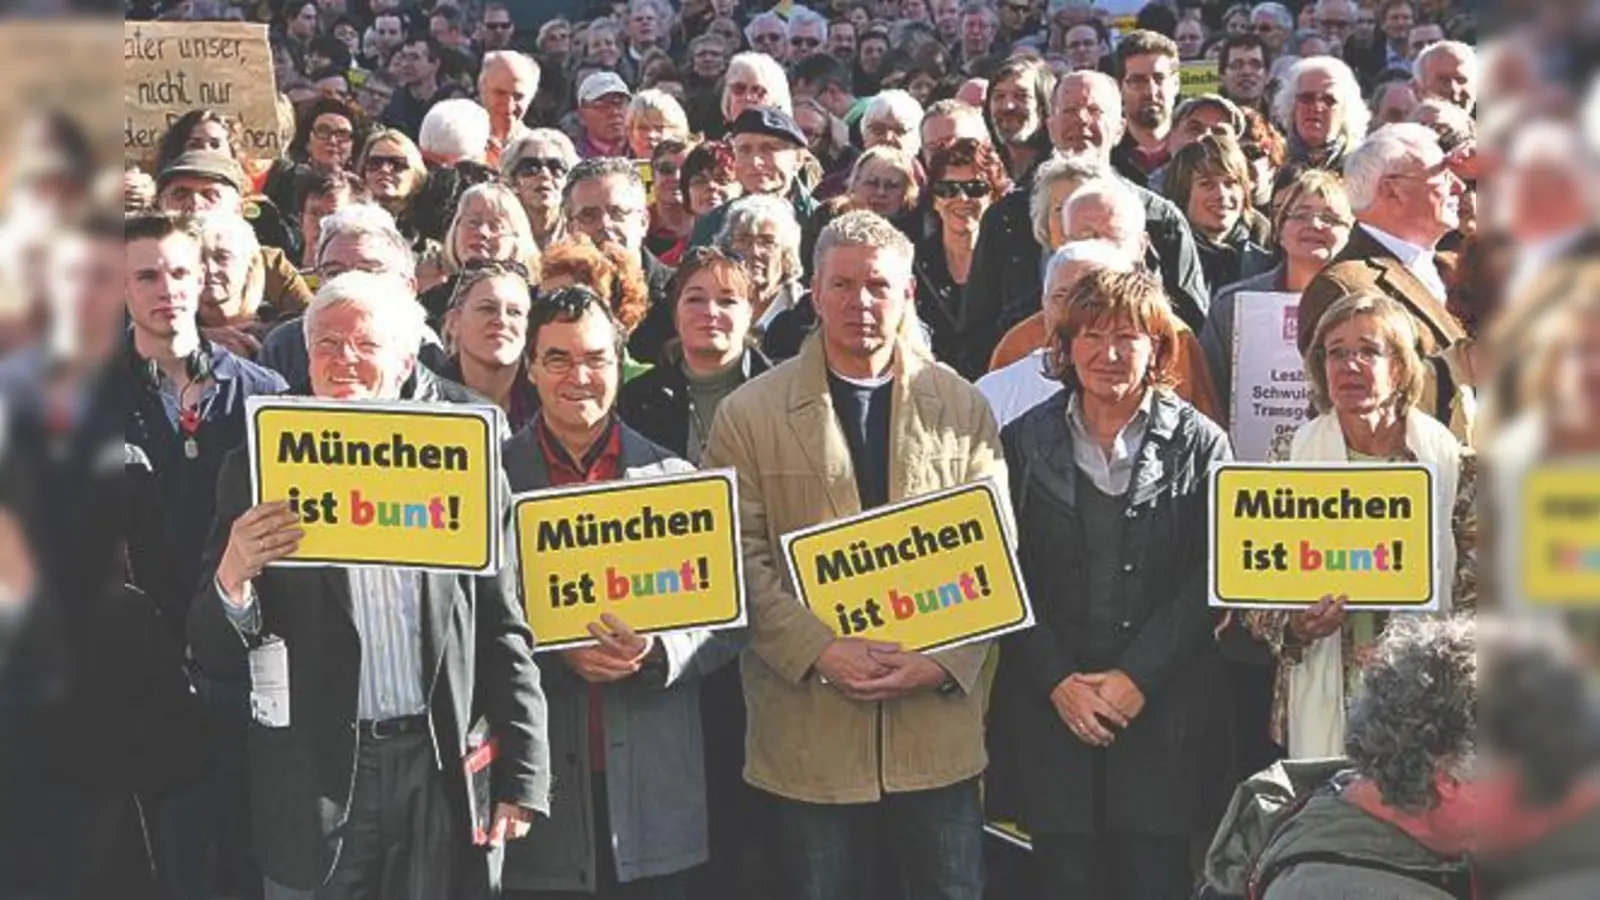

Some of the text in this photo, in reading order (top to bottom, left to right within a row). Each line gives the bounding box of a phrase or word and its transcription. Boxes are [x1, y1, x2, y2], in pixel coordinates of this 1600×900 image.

[178, 37, 246, 65] unser,
[138, 69, 232, 105] nicht nur
[1252, 385, 1309, 400] Schwul
[1270, 368, 1304, 383] Lesb
[1253, 402, 1304, 421] Transg
[277, 429, 469, 472] München
[288, 486, 460, 531] ist bunt!
[1234, 487, 1412, 520] München
[536, 506, 714, 552] München
[814, 518, 984, 585] München
[1242, 539, 1404, 572] ist bunt!
[549, 556, 710, 609] ist bunt!
[834, 564, 992, 636] ist bunt!
